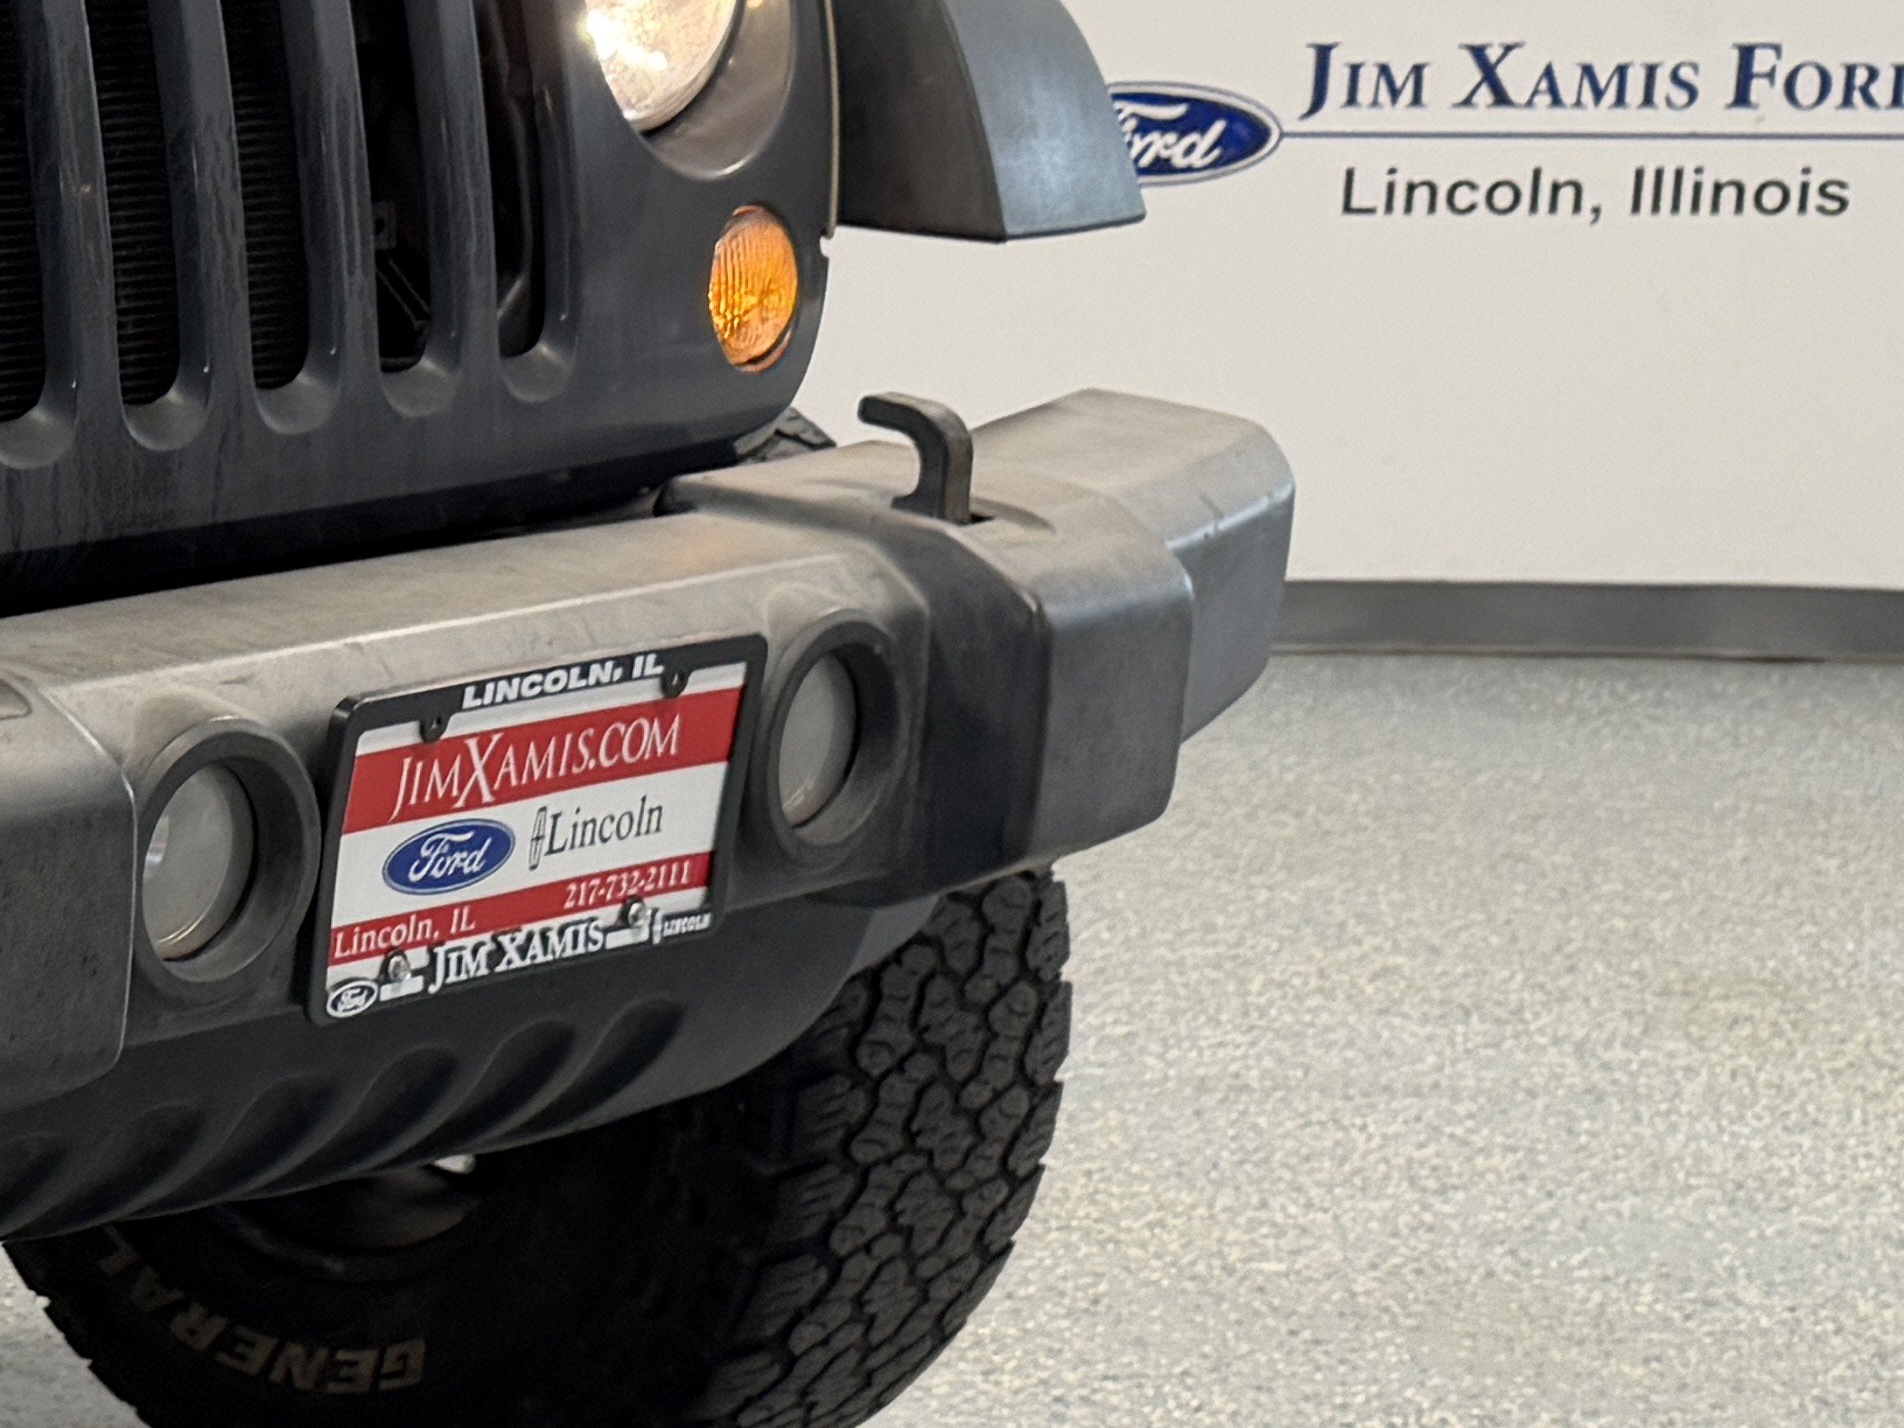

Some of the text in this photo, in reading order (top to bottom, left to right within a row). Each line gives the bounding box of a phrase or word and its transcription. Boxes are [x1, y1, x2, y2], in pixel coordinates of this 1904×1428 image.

[1298, 41, 1430, 120] JIM
[1452, 42, 1700, 110] XAMIS
[1341, 165, 1850, 226] Lincoln, Illinois
[462, 652, 665, 710] LINCOLN, IL
[389, 713, 681, 823] JIMXAMIS.COM
[408, 830, 492, 883] Ford
[544, 795, 664, 857] Lincoln
[563, 861, 692, 910] 217-732-2111
[333, 906, 476, 959] Lincoln, IL
[428, 918, 605, 994] JIM XAMIS
[94, 1222, 427, 1394] GENERAL
